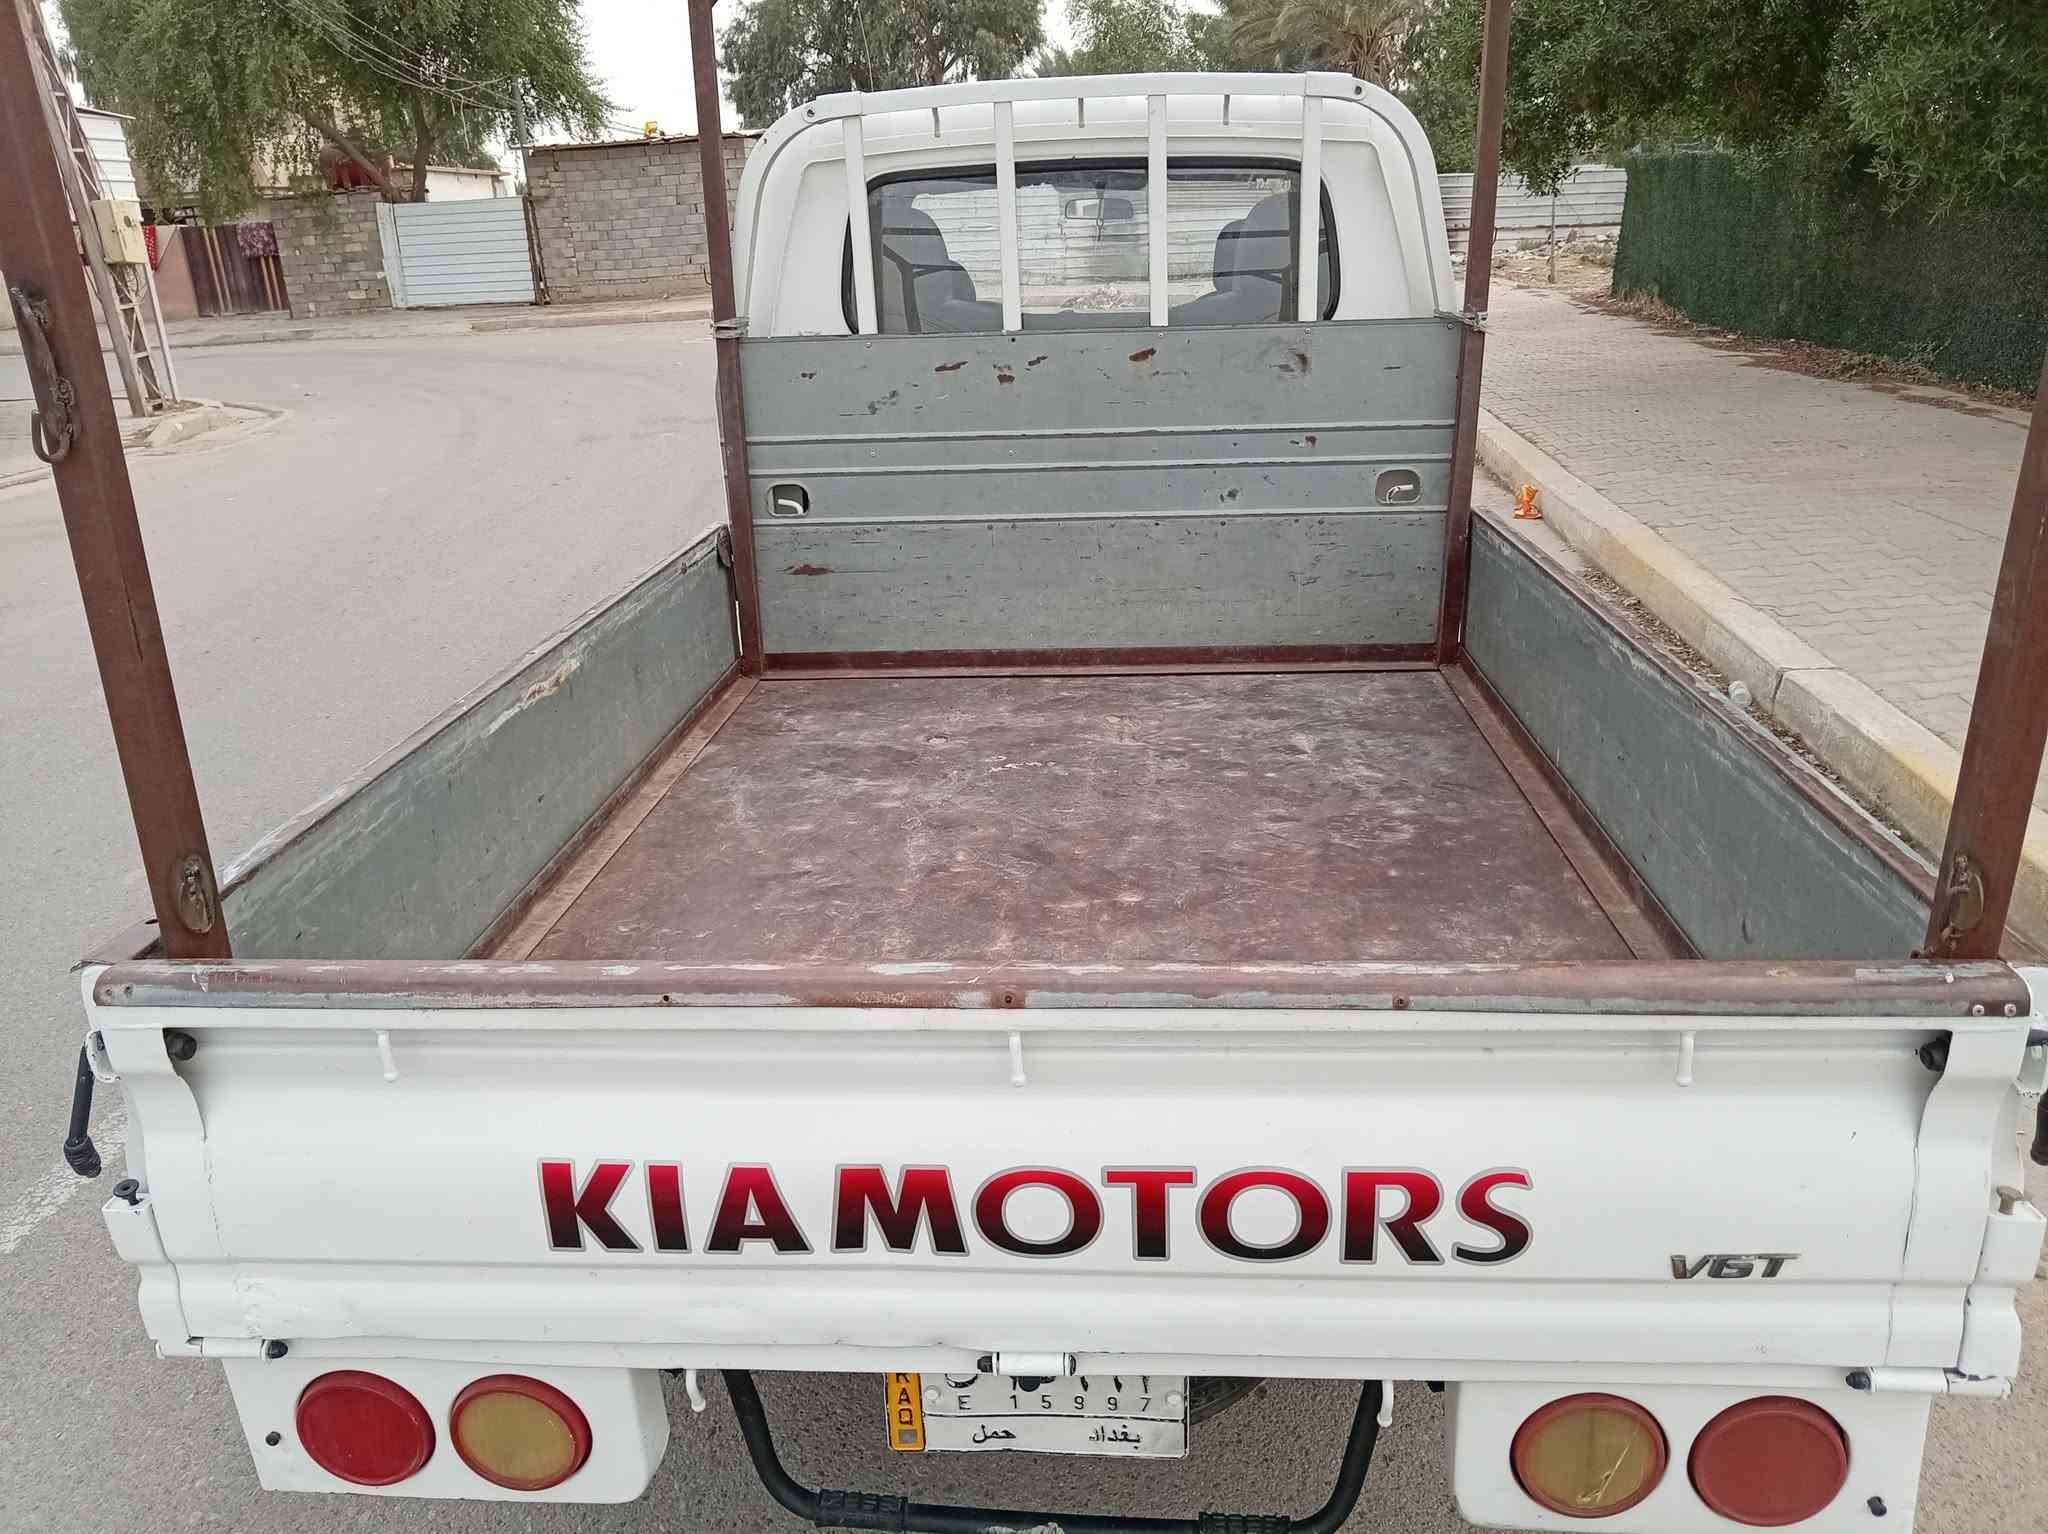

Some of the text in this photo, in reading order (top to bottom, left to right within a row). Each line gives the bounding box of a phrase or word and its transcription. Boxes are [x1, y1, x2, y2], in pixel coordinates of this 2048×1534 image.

[957, 1394, 971, 1411] E
[972, 1424, 1142, 1450] بغداد حمل
